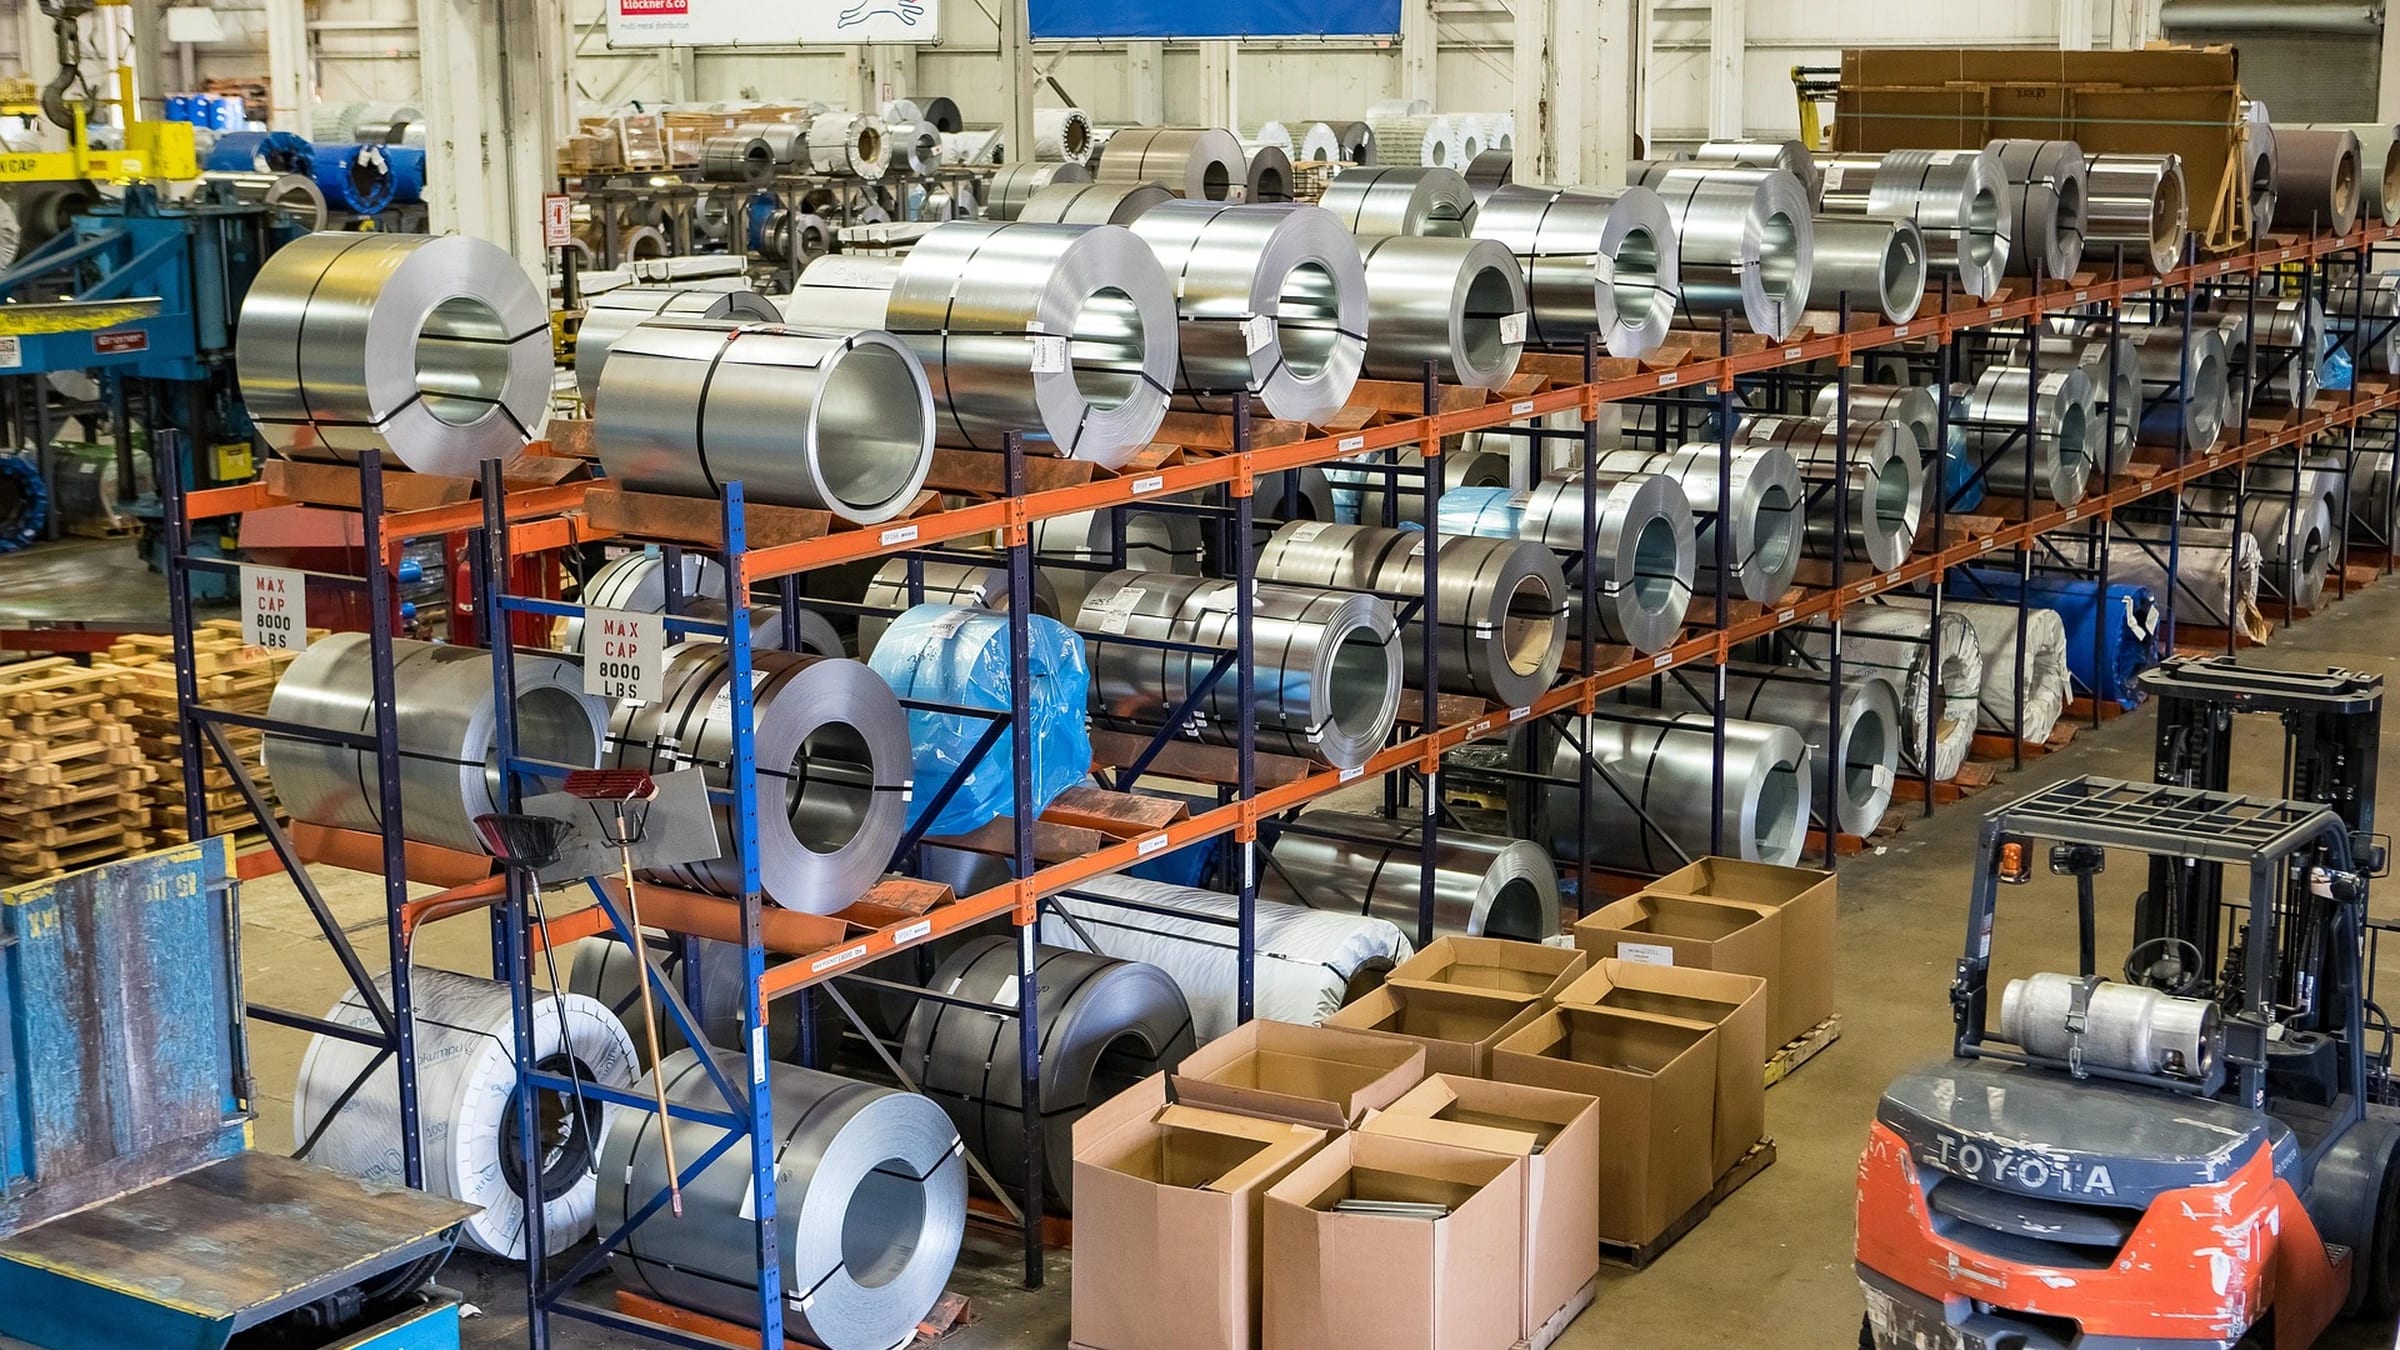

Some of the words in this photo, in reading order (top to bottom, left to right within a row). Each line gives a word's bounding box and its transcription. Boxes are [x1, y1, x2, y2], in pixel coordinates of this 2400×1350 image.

[256, 576, 285, 593] MAX
[258, 596, 285, 612] CAP
[257, 614, 291, 631] 8000
[604, 619, 638, 638] MAX
[259, 631, 287, 648] LBS
[605, 641, 637, 659] CAP
[599, 661, 640, 681] 8000
[604, 680, 637, 699] LBS
[1936, 1134, 2117, 1197] TOYOTA
